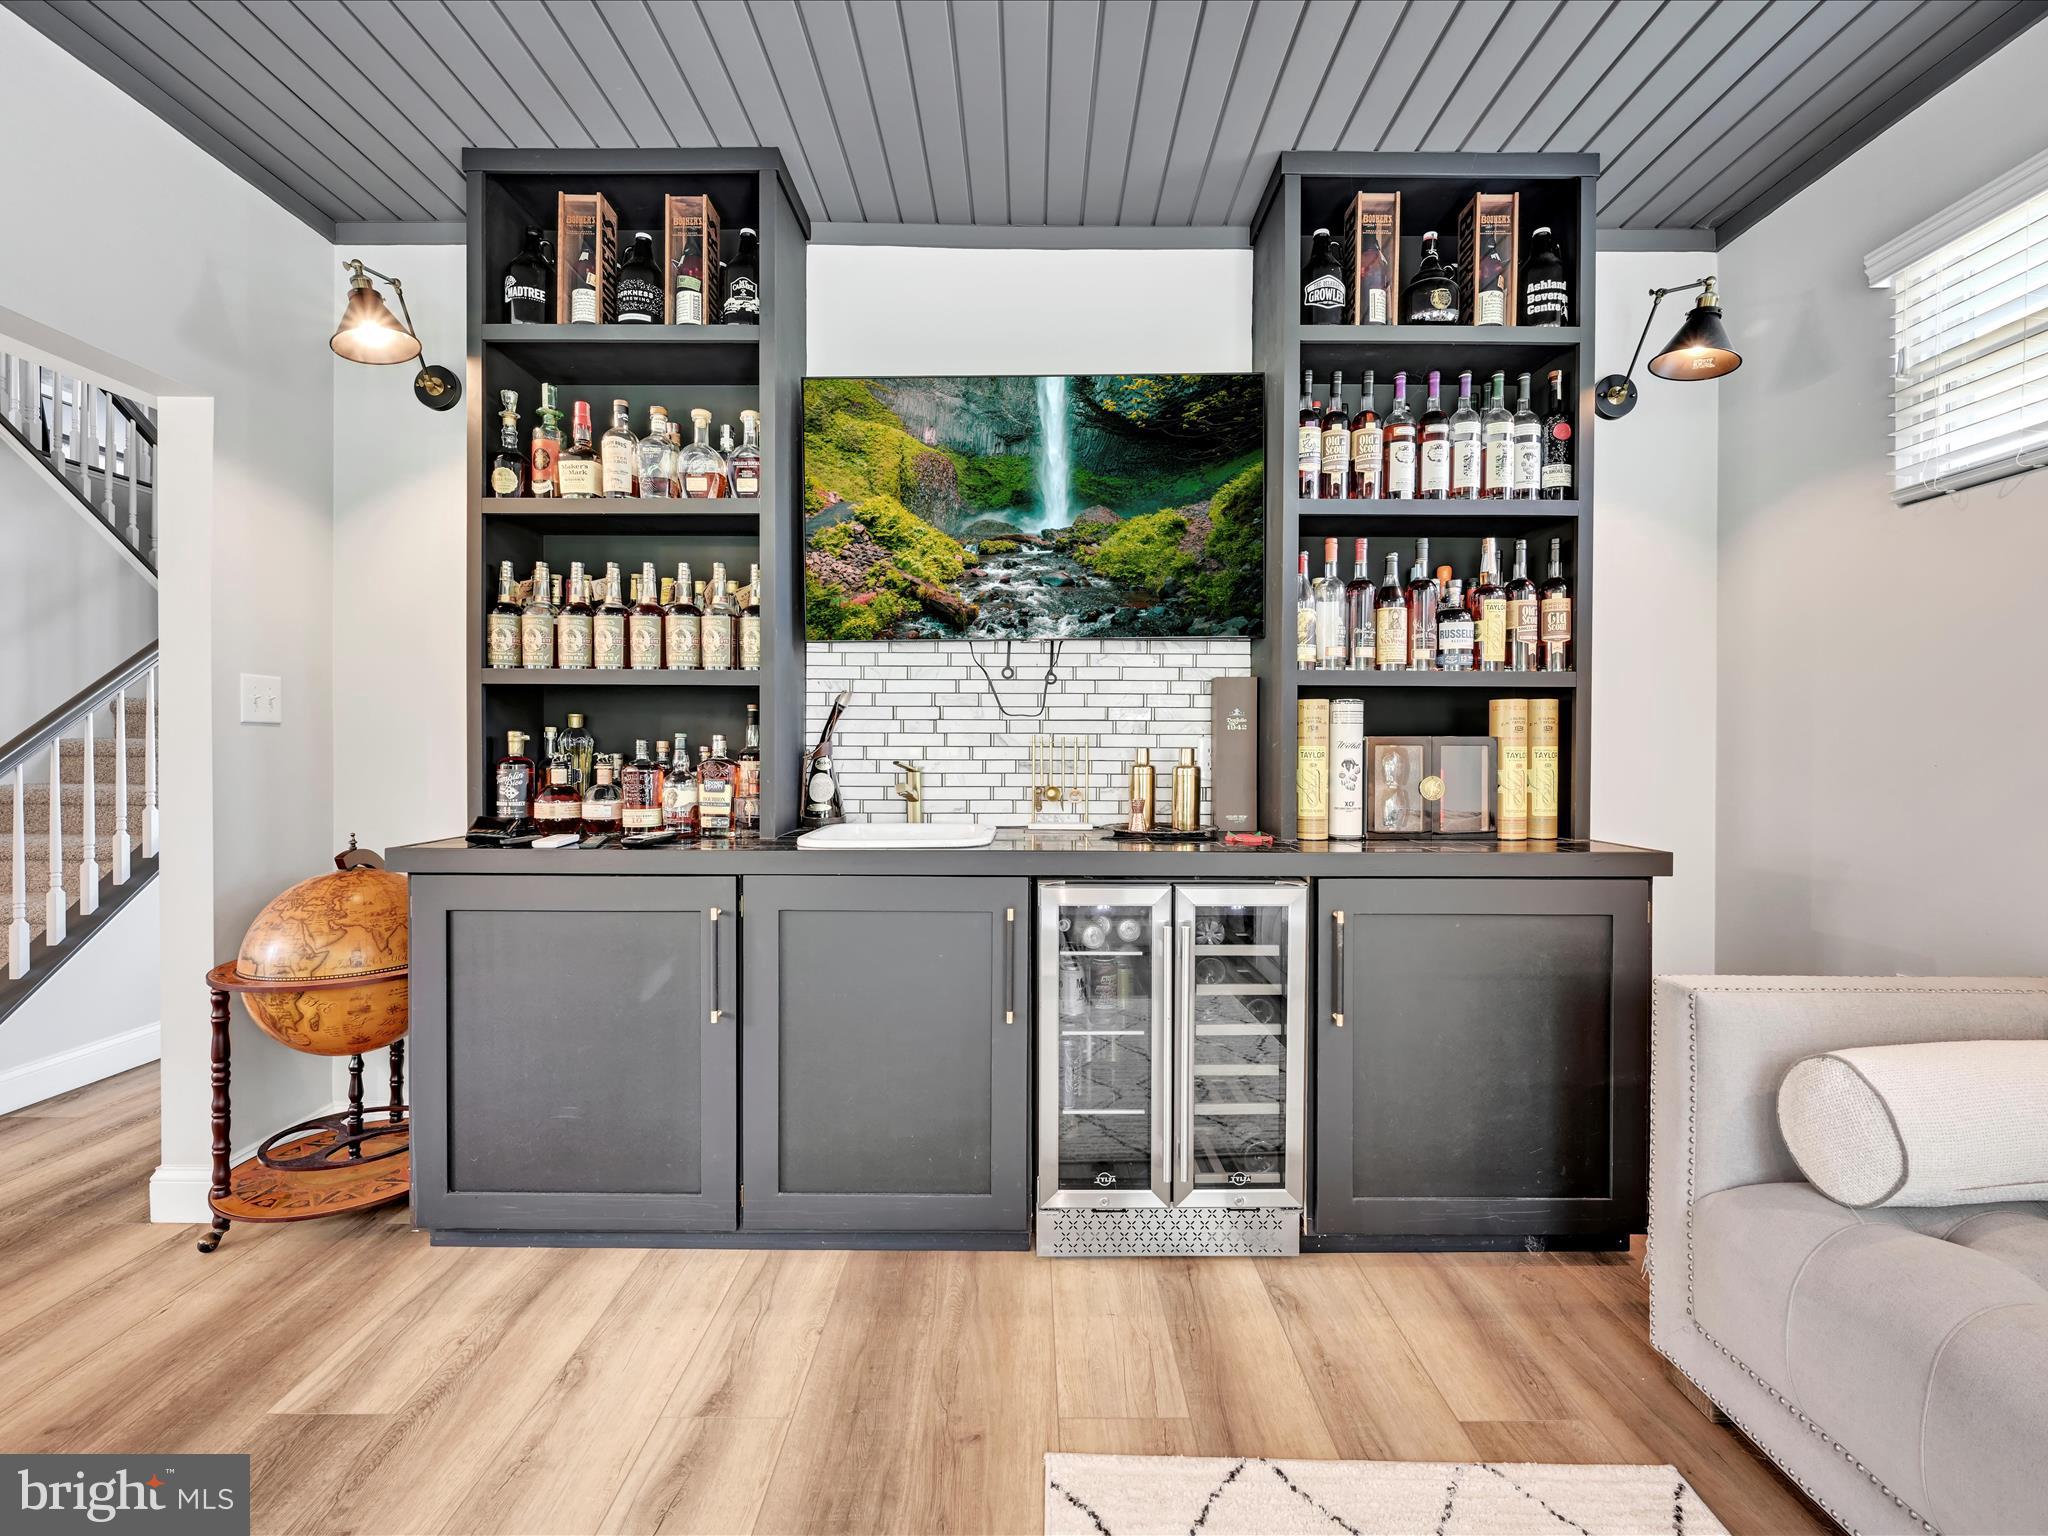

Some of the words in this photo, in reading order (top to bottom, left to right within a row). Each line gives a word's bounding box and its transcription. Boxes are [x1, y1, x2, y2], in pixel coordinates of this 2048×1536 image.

[507, 286, 546, 301] MADTREE
[1527, 279, 1567, 294] Ashland
[1308, 288, 1344, 303] GROWLER
[1527, 302, 1561, 316] Centre
[561, 463, 589, 471] Maker's
[1300, 751, 1326, 759] TAYLOR
